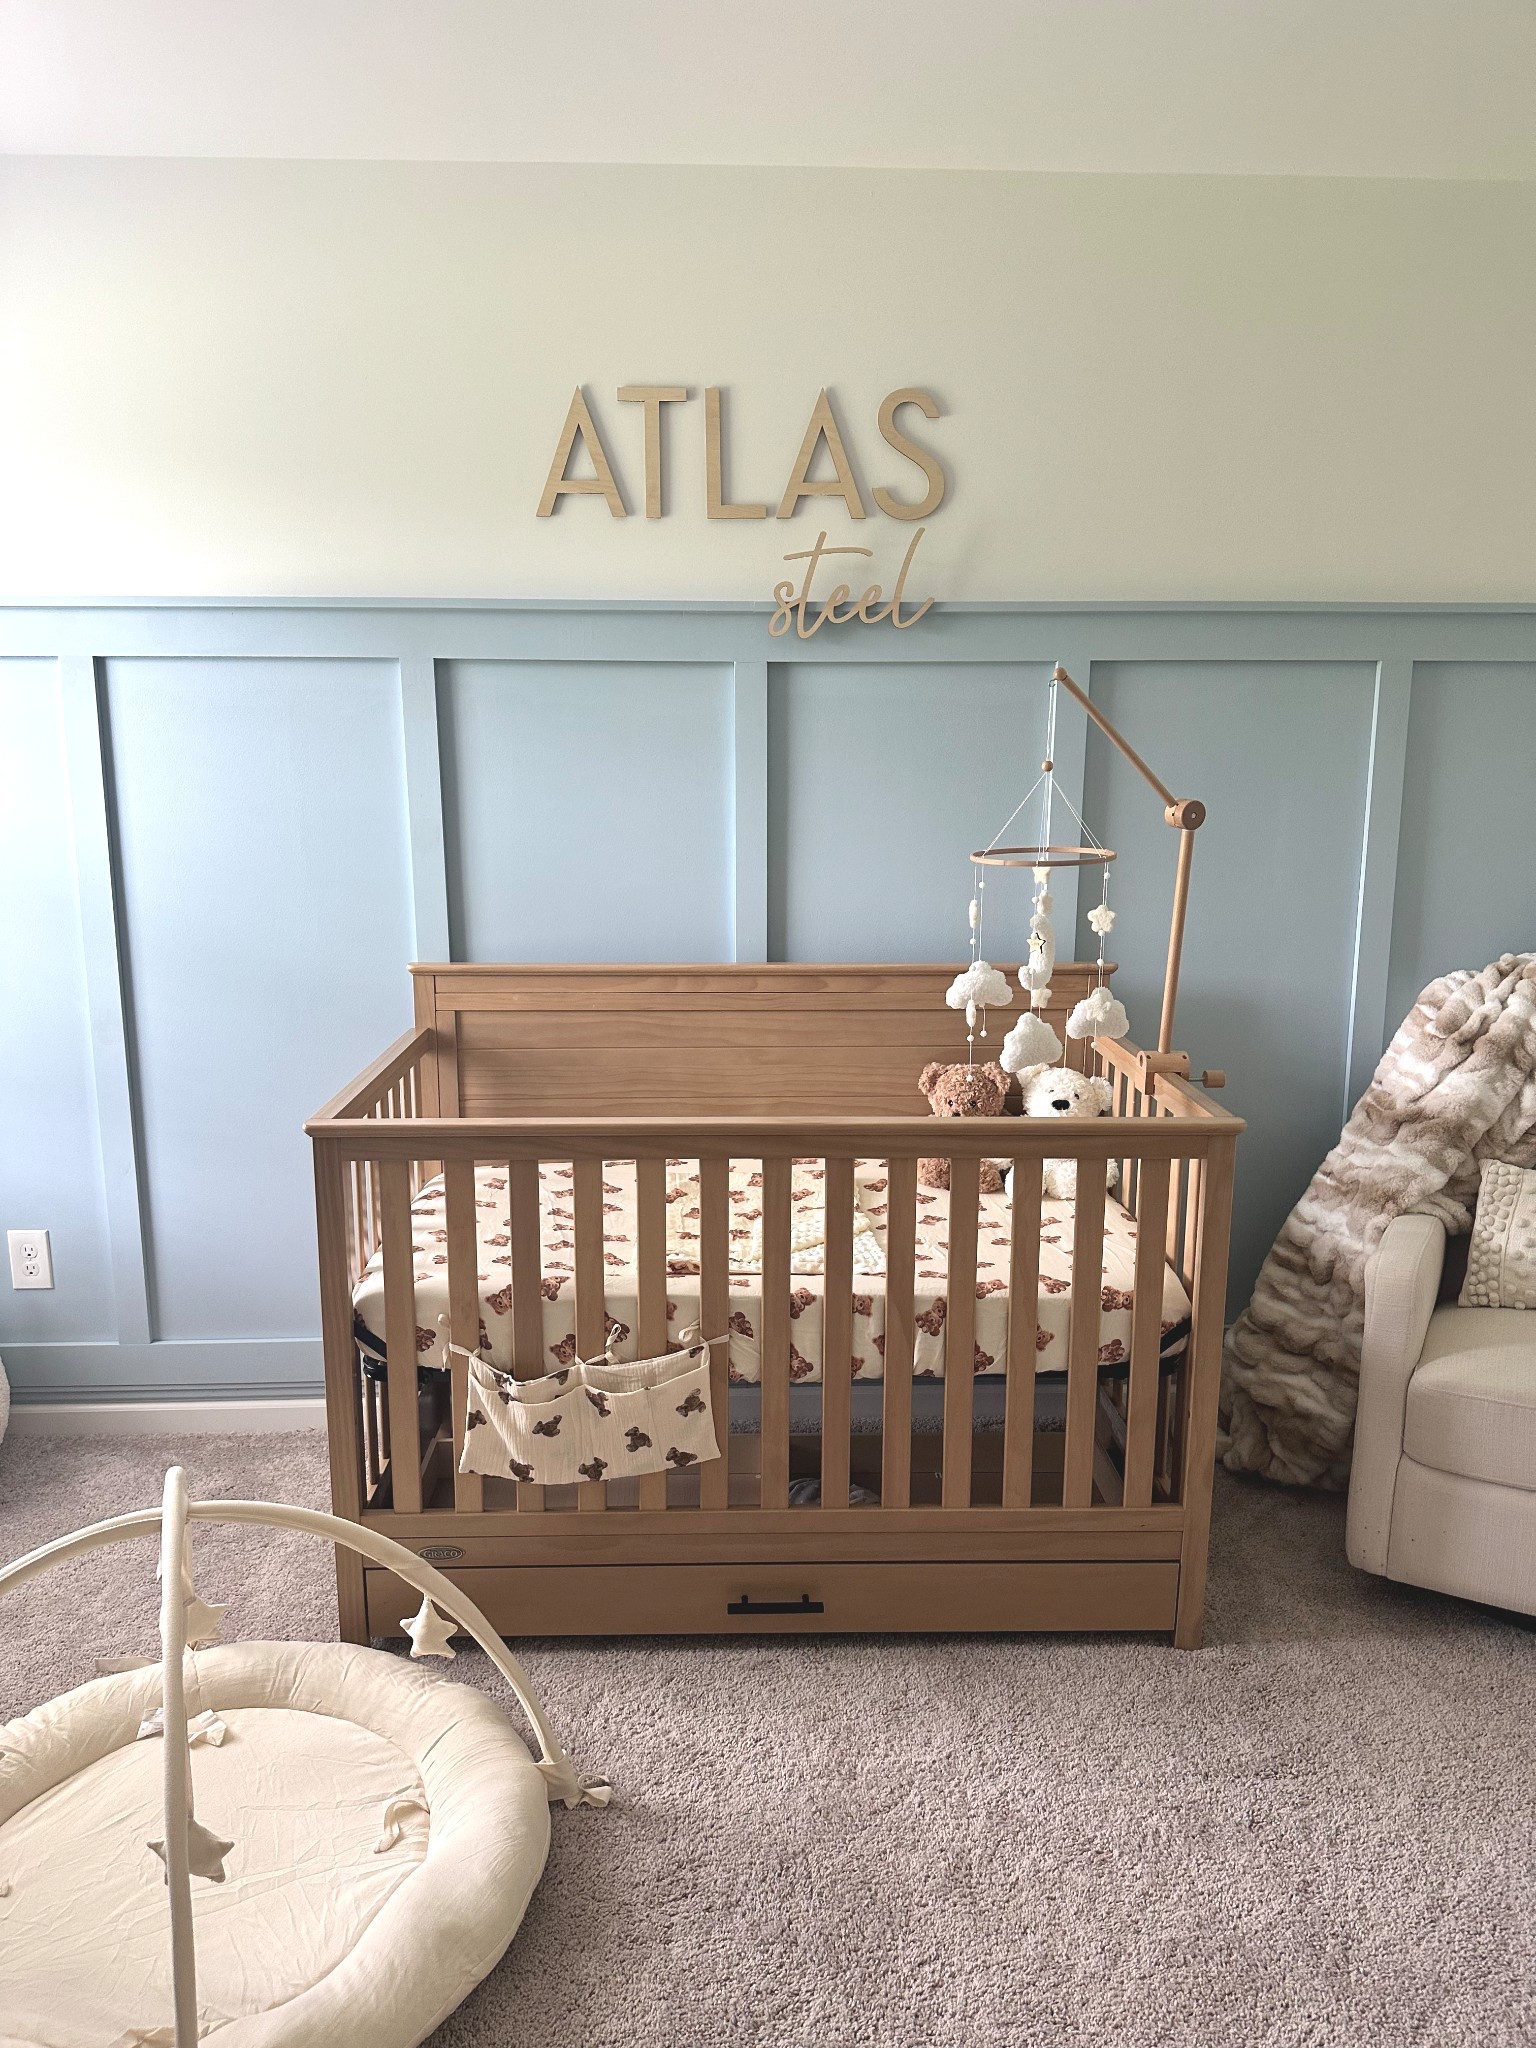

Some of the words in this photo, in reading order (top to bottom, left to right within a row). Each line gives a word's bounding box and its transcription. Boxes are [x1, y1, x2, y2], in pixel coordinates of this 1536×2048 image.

[536, 385, 946, 520] ATLAS
[768, 527, 935, 639] steel
[423, 1550, 458, 1558] GRACO
